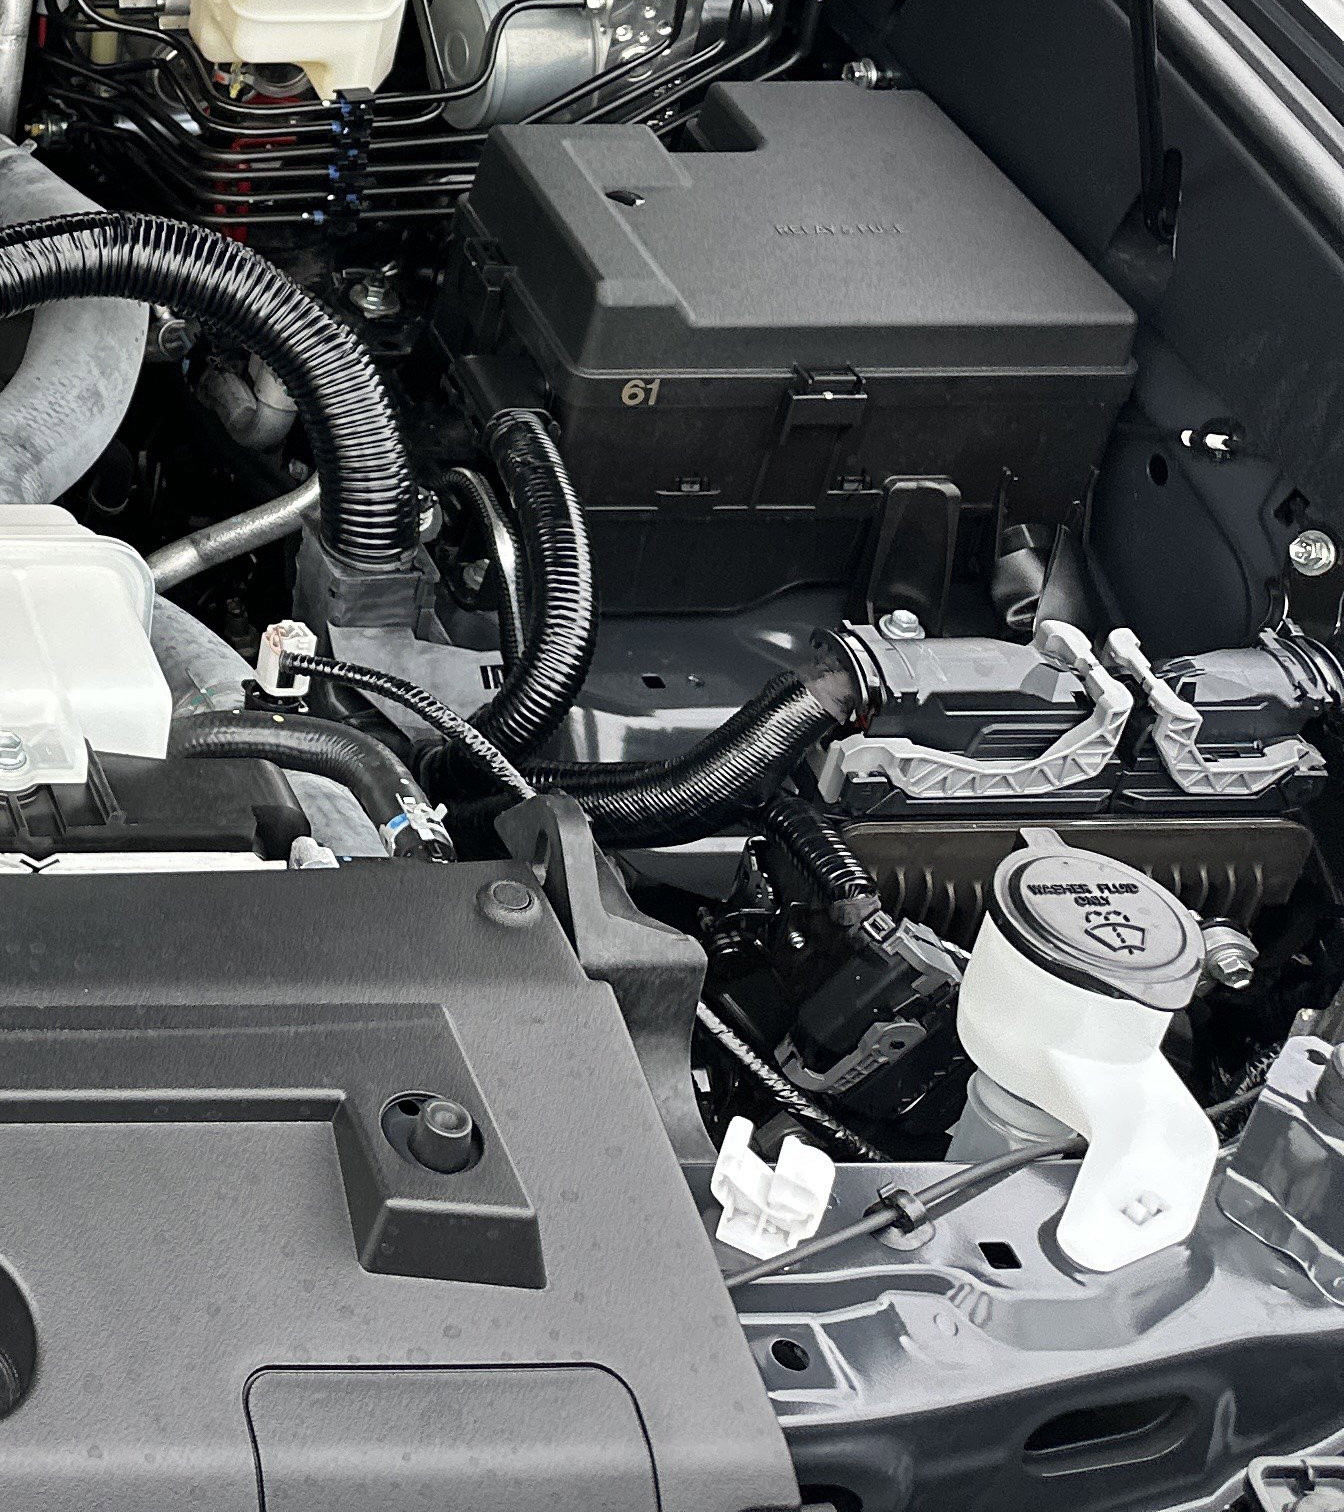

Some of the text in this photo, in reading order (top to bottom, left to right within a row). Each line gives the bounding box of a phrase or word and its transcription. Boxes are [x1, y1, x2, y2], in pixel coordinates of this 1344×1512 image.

[620, 378, 661, 407] 61
[1026, 882, 1140, 896] WASHER FLUID
[1073, 895, 1111, 908] ONLY
